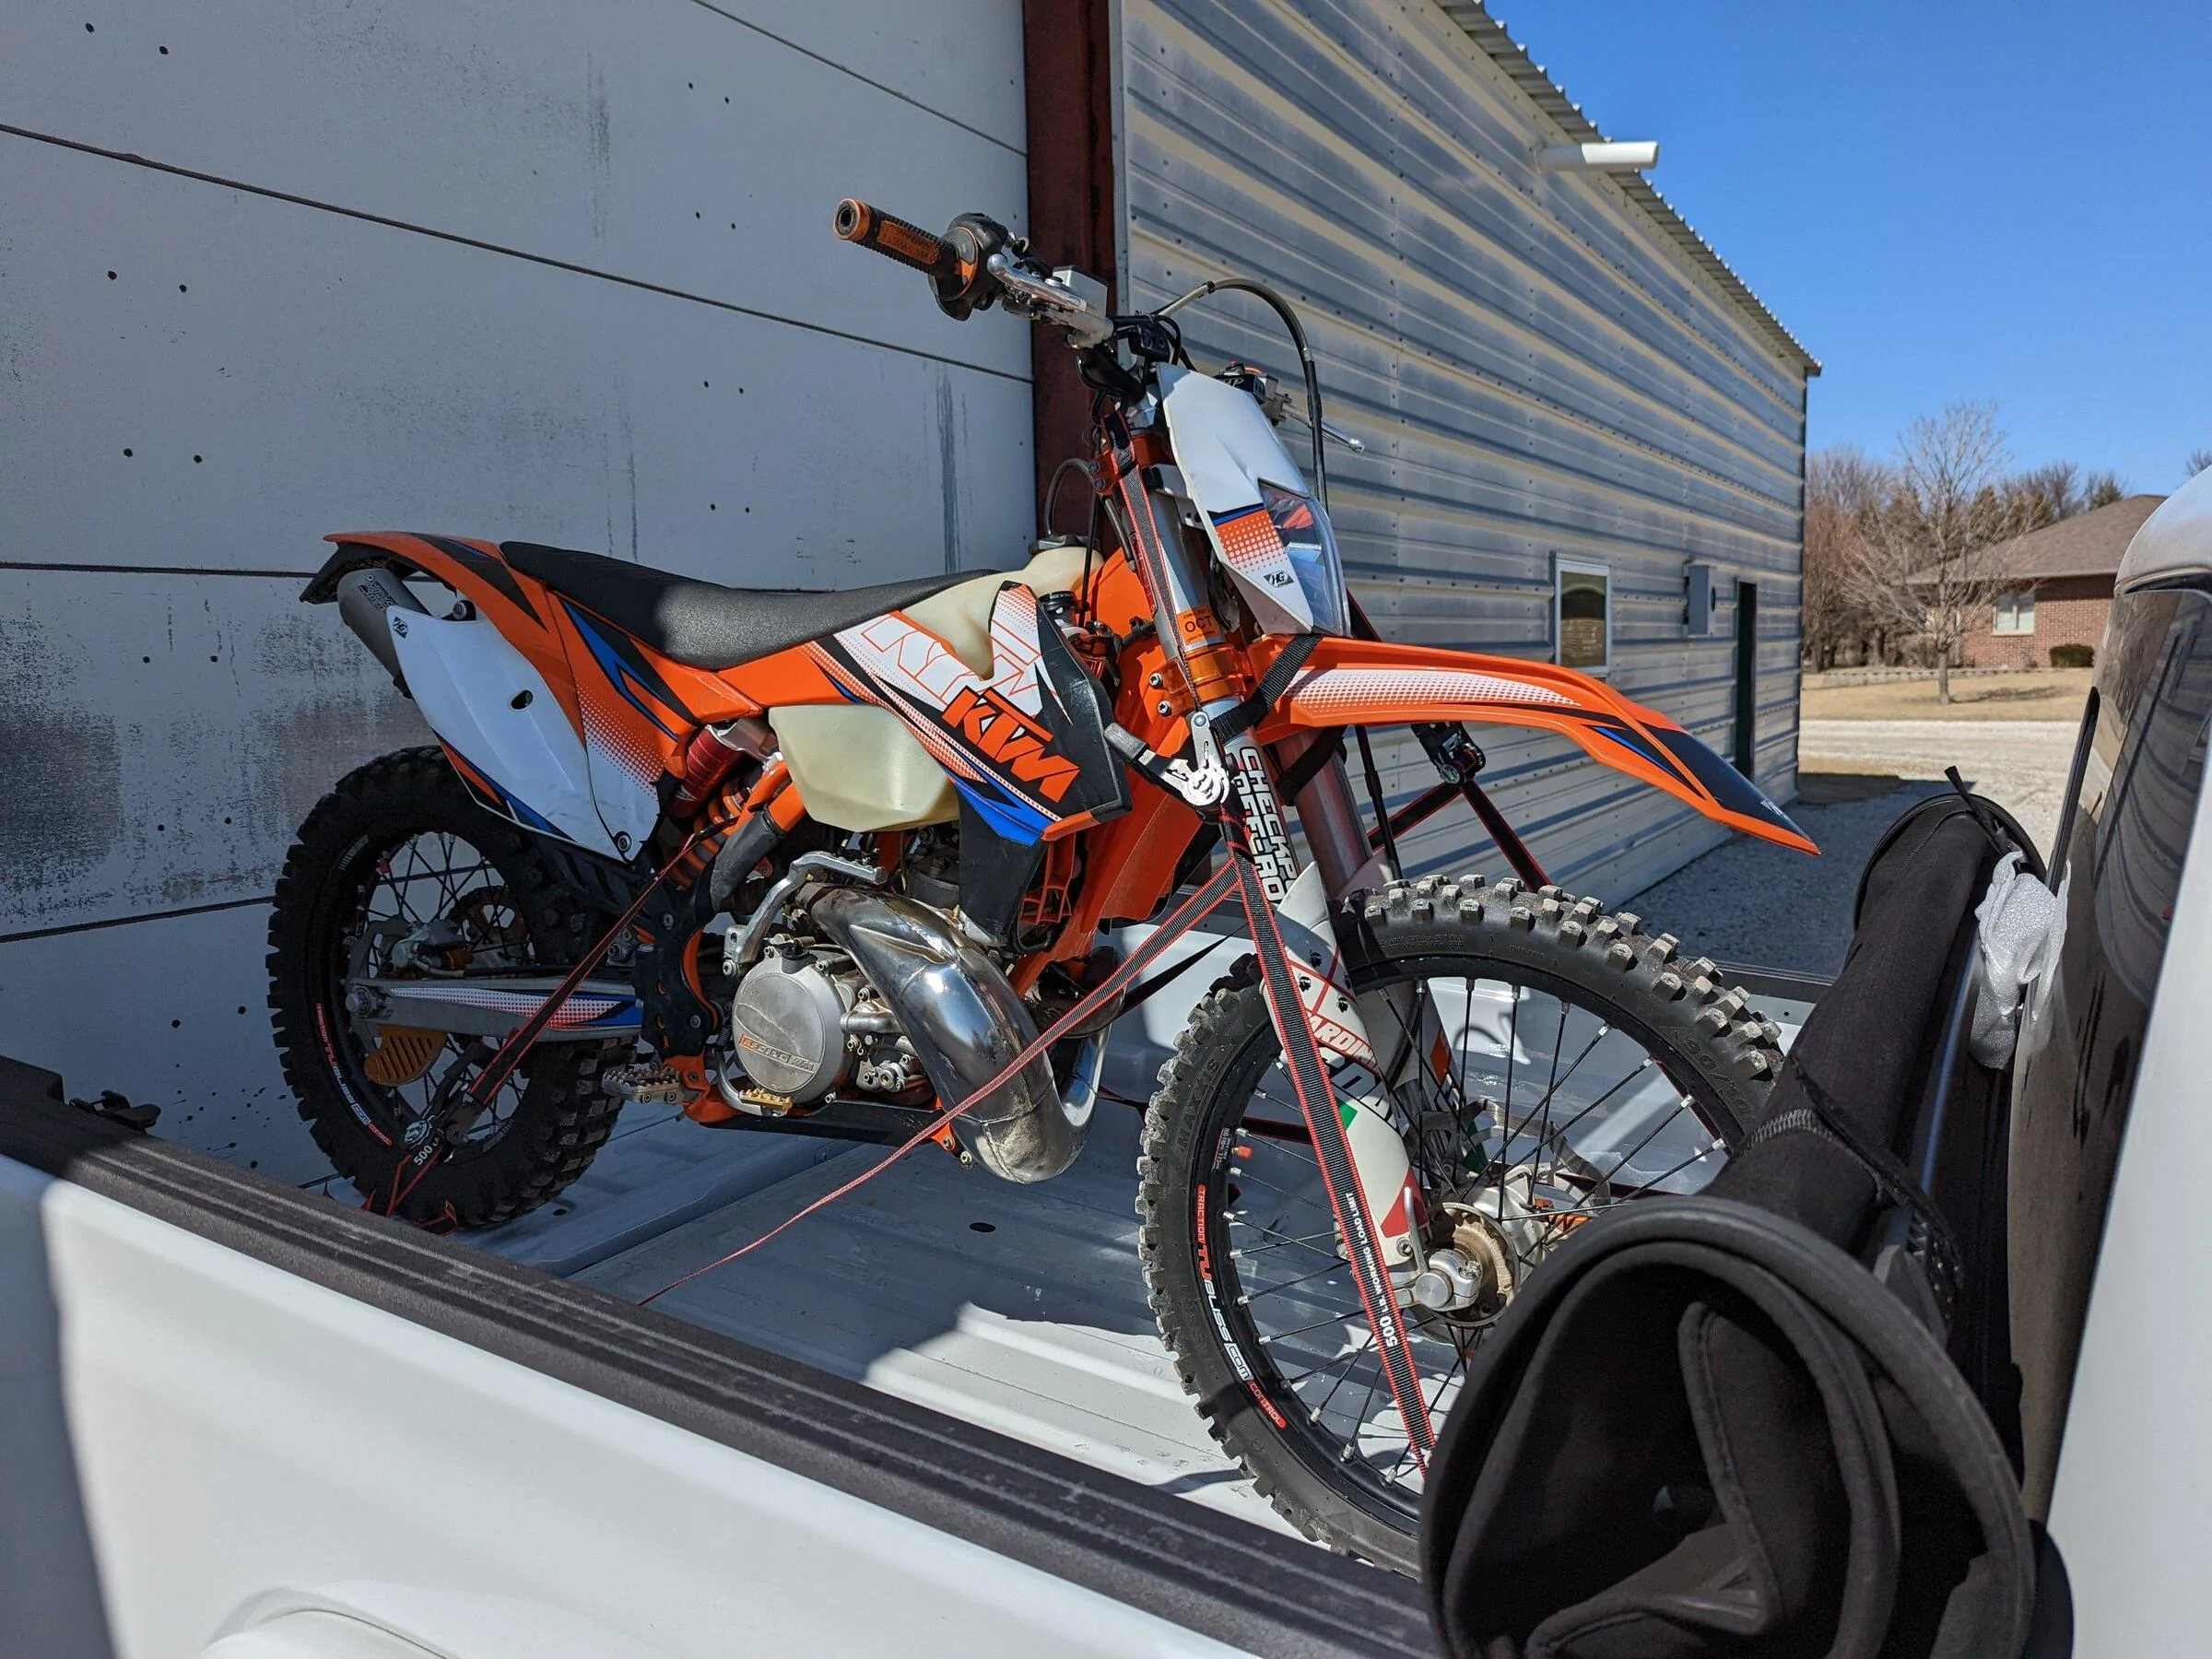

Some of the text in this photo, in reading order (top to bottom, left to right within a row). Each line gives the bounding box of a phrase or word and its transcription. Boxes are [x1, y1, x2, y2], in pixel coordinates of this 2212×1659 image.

[1184, 615, 1212, 633] OCT
[940, 686, 1080, 804] KTM
[413, 1144, 433, 1166] 500
[1346, 1192, 1359, 1218] LIMIT
[1354, 1217, 1369, 1245] LOAD
[1363, 1246, 1382, 1295] WORKING
[1196, 1188, 1206, 1241] TRACTION
[1248, 1384, 1282, 1424] CONTROL
[1379, 1316, 1398, 1347] 500
